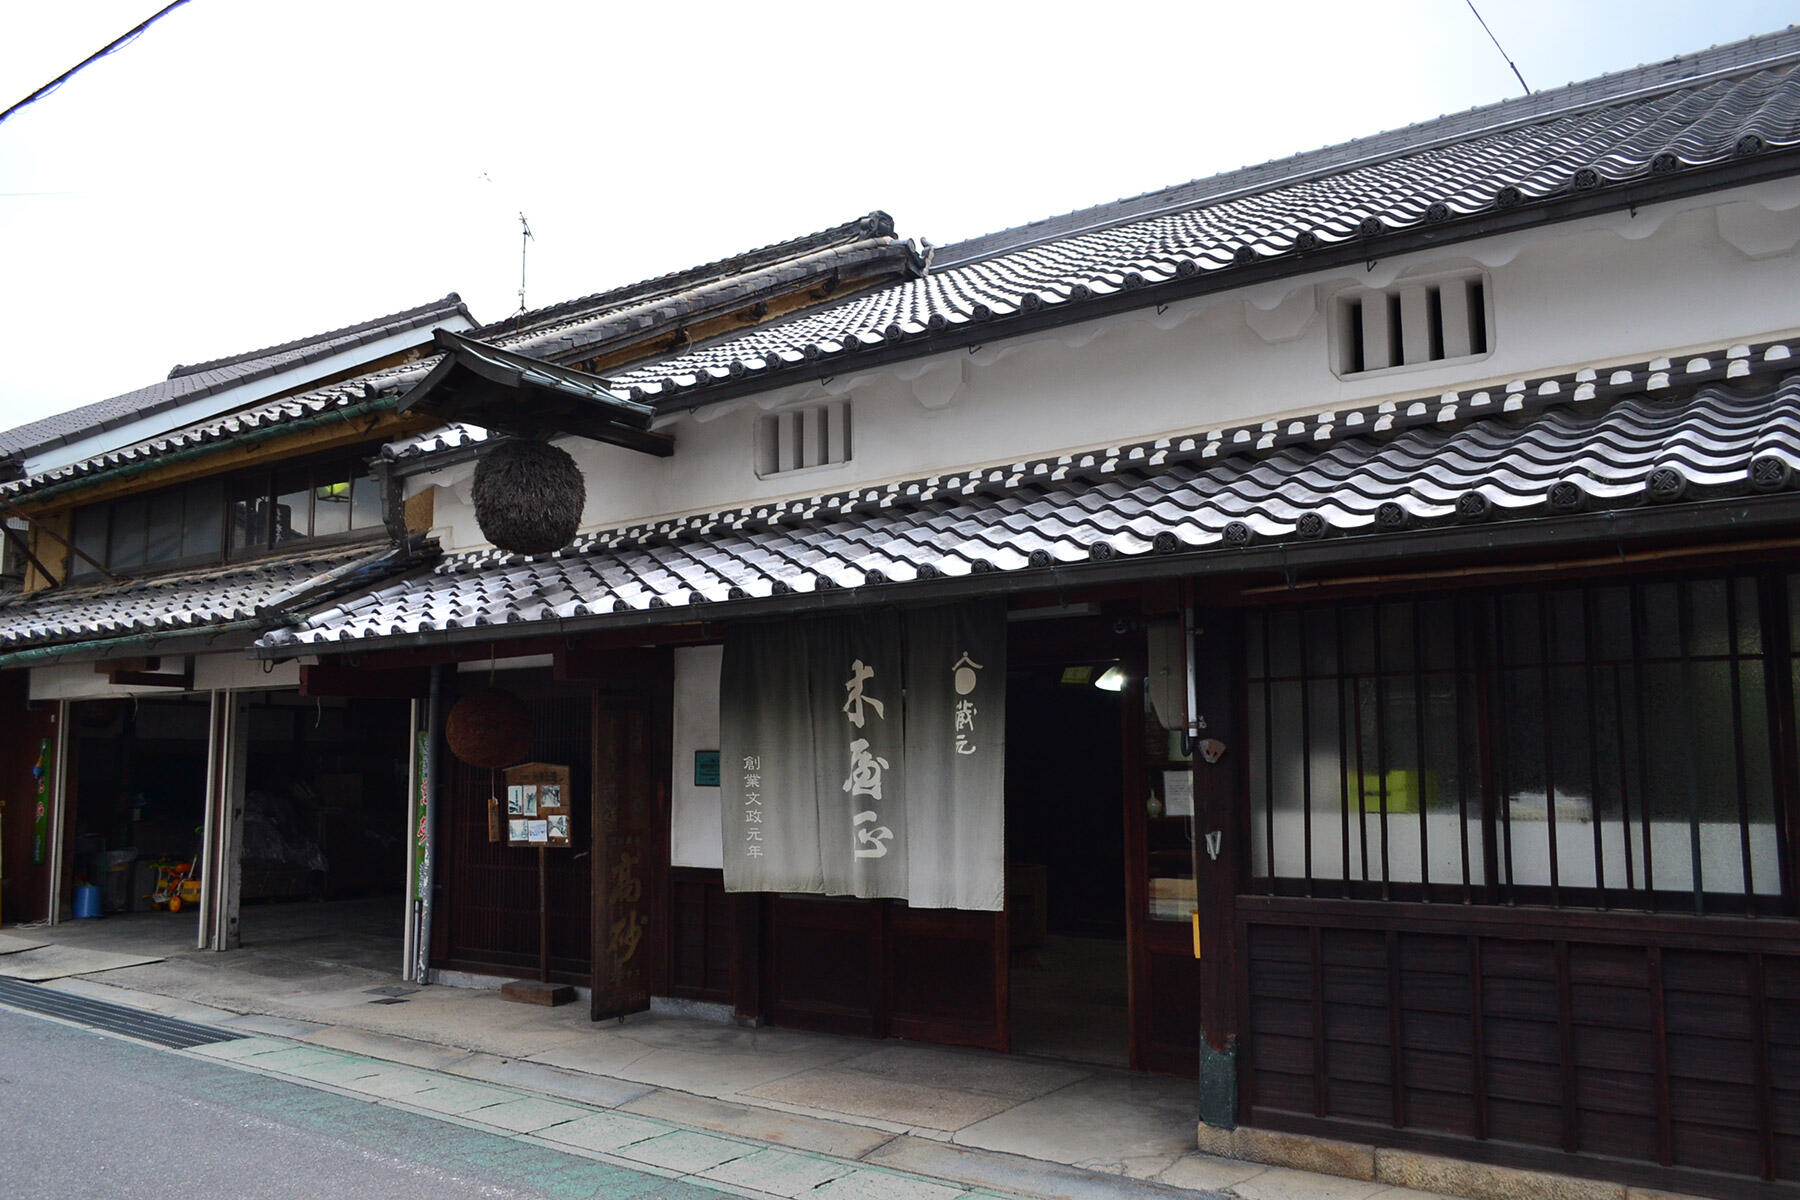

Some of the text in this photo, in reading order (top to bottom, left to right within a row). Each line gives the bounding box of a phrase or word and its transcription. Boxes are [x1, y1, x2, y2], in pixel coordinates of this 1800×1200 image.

[843, 659, 894, 862] 木屋正
[954, 699, 977, 755] 蔵元
[743, 755, 764, 859] 創業文政元年
